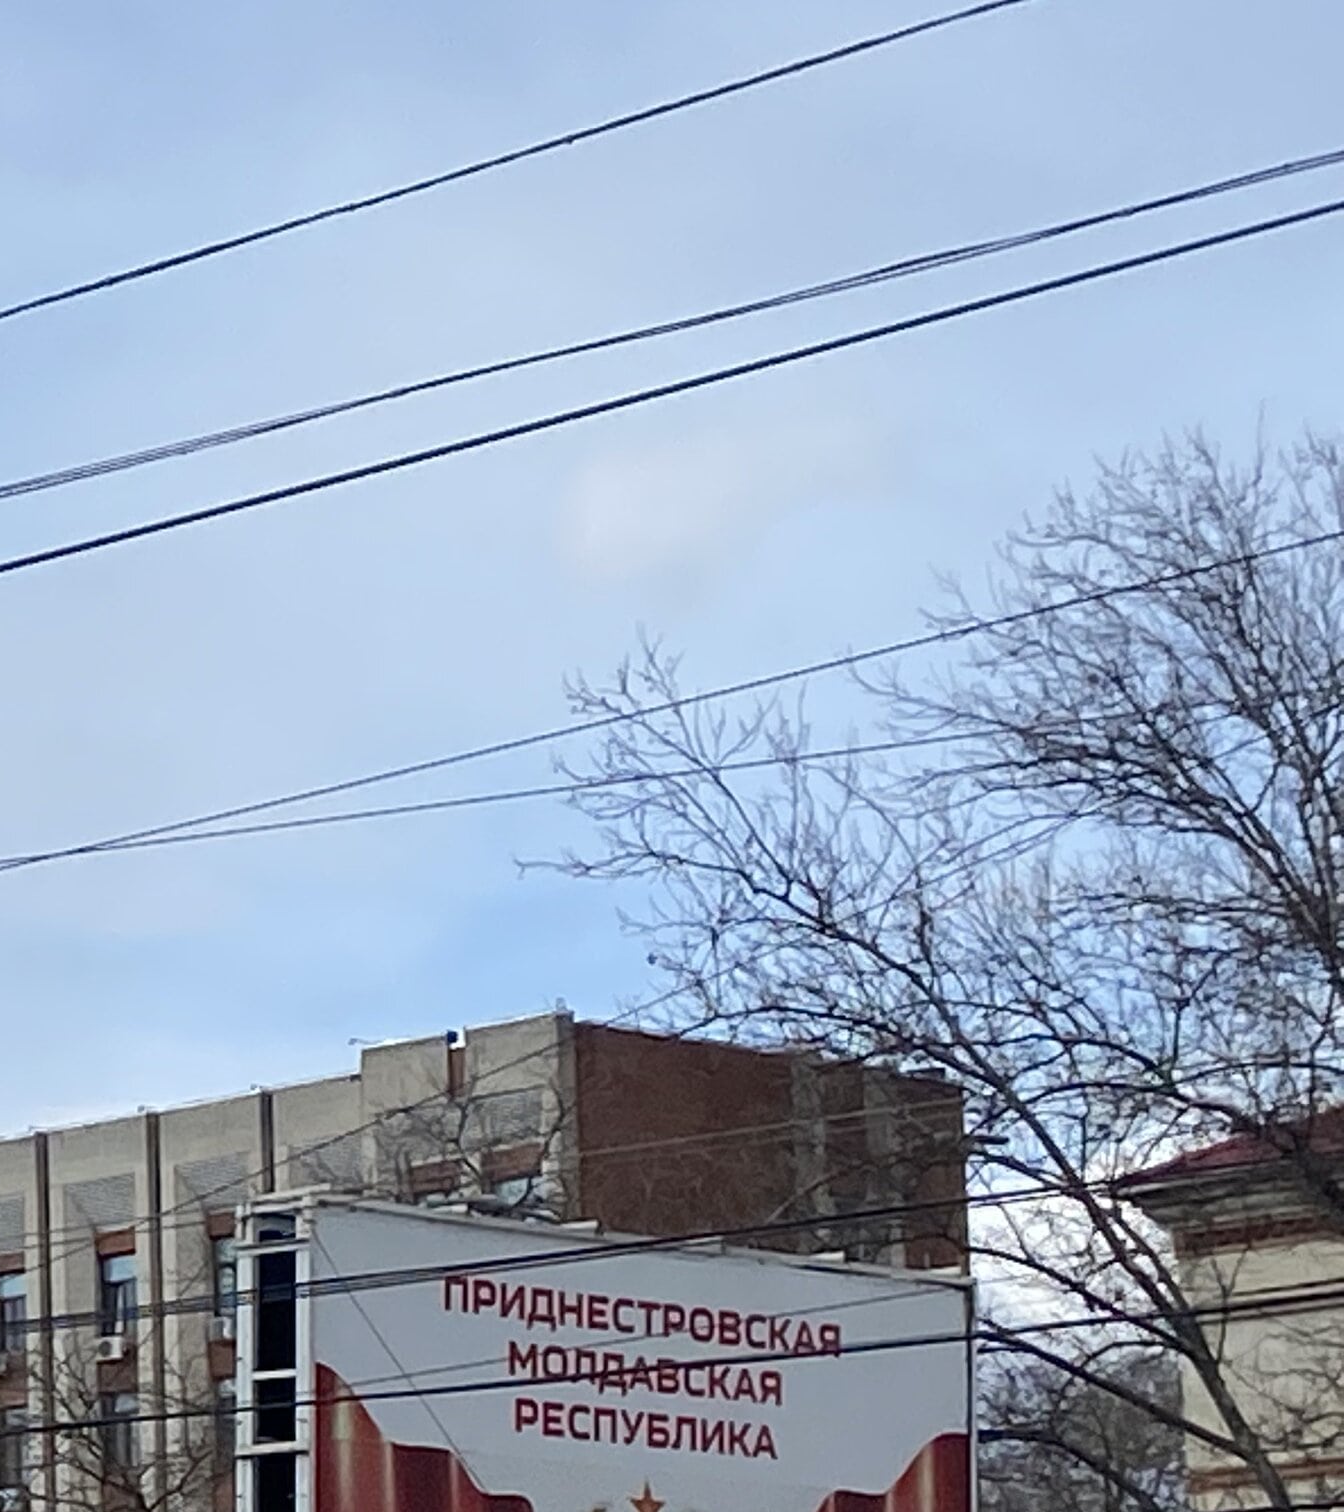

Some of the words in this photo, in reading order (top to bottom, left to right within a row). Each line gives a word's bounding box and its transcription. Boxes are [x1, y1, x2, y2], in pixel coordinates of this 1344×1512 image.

[444, 1275, 842, 1357] ПРИДНЕСТРОВСКАЯ
[508, 1341, 782, 1406] МОЛДАВСКАЯ
[514, 1398, 778, 1460] РЕСПУБЛИКА
